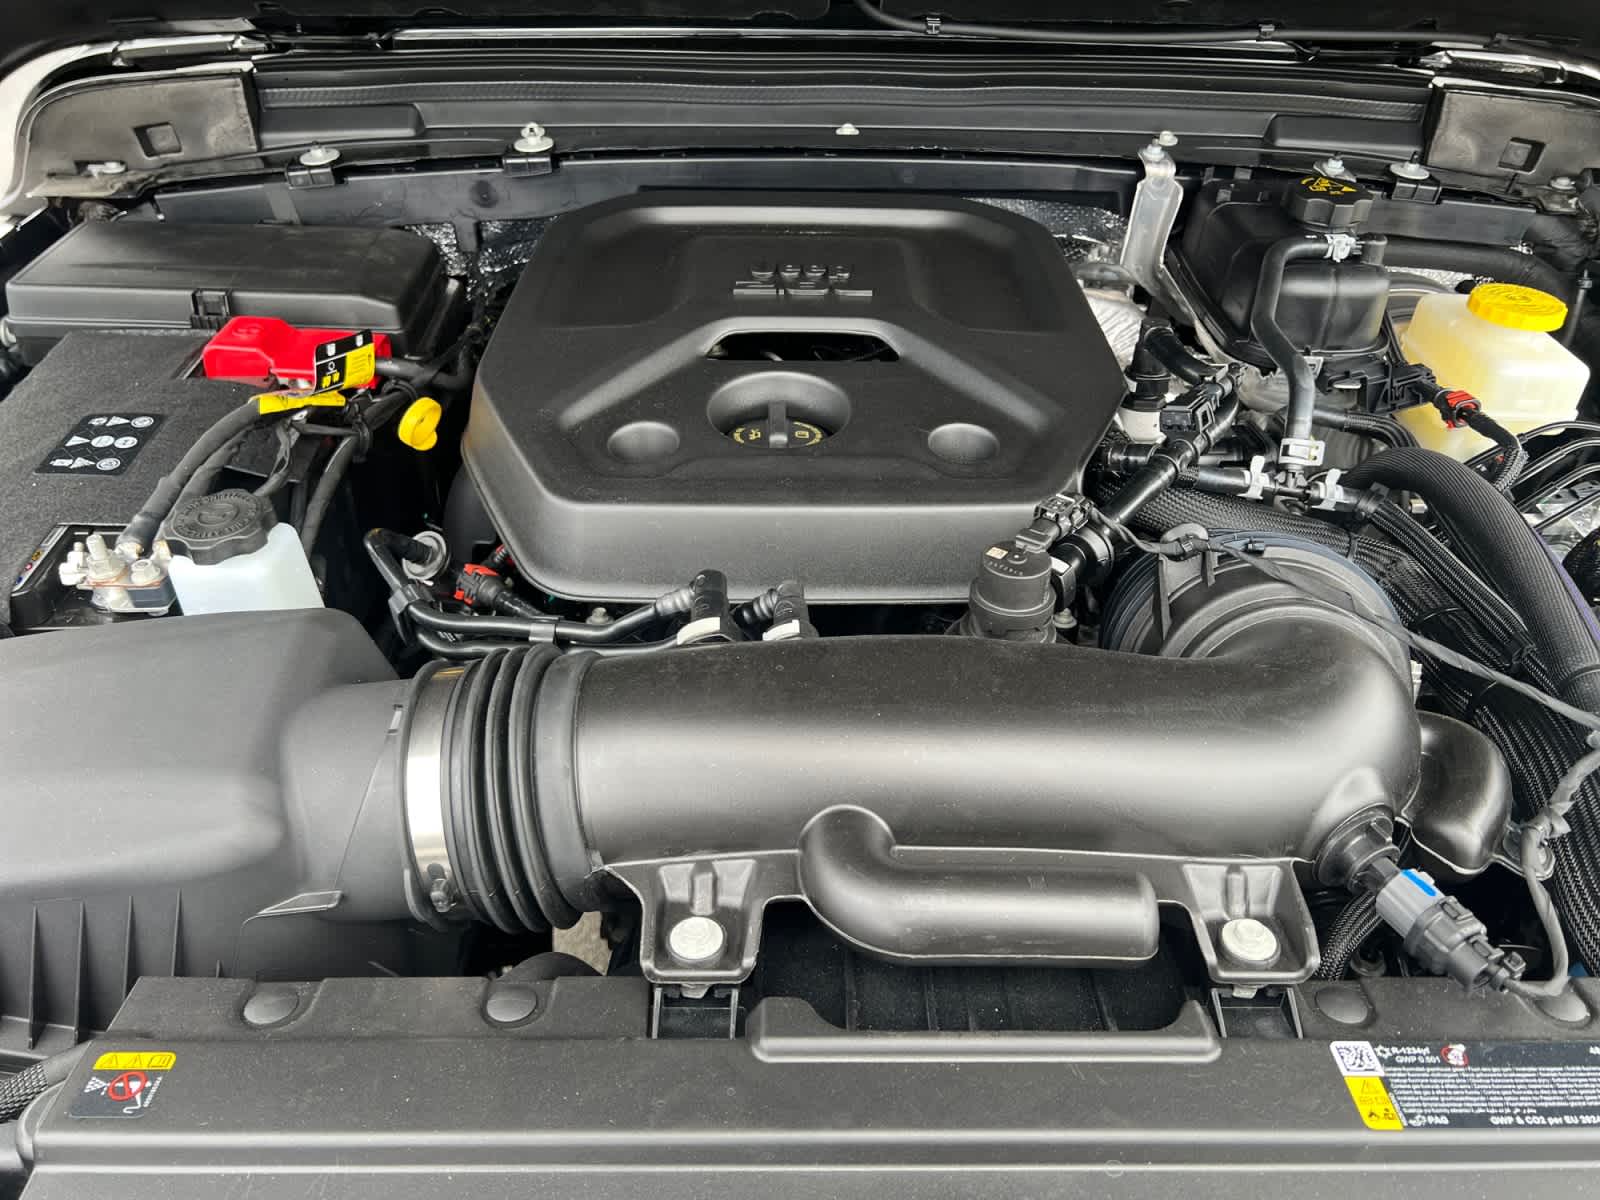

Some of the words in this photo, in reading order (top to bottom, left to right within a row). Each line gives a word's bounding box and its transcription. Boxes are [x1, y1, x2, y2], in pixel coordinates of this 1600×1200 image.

[1489, 1115, 1514, 1125] GWP
[1524, 1115, 1547, 1125] CO2
[1563, 1115, 1579, 1124] EU
